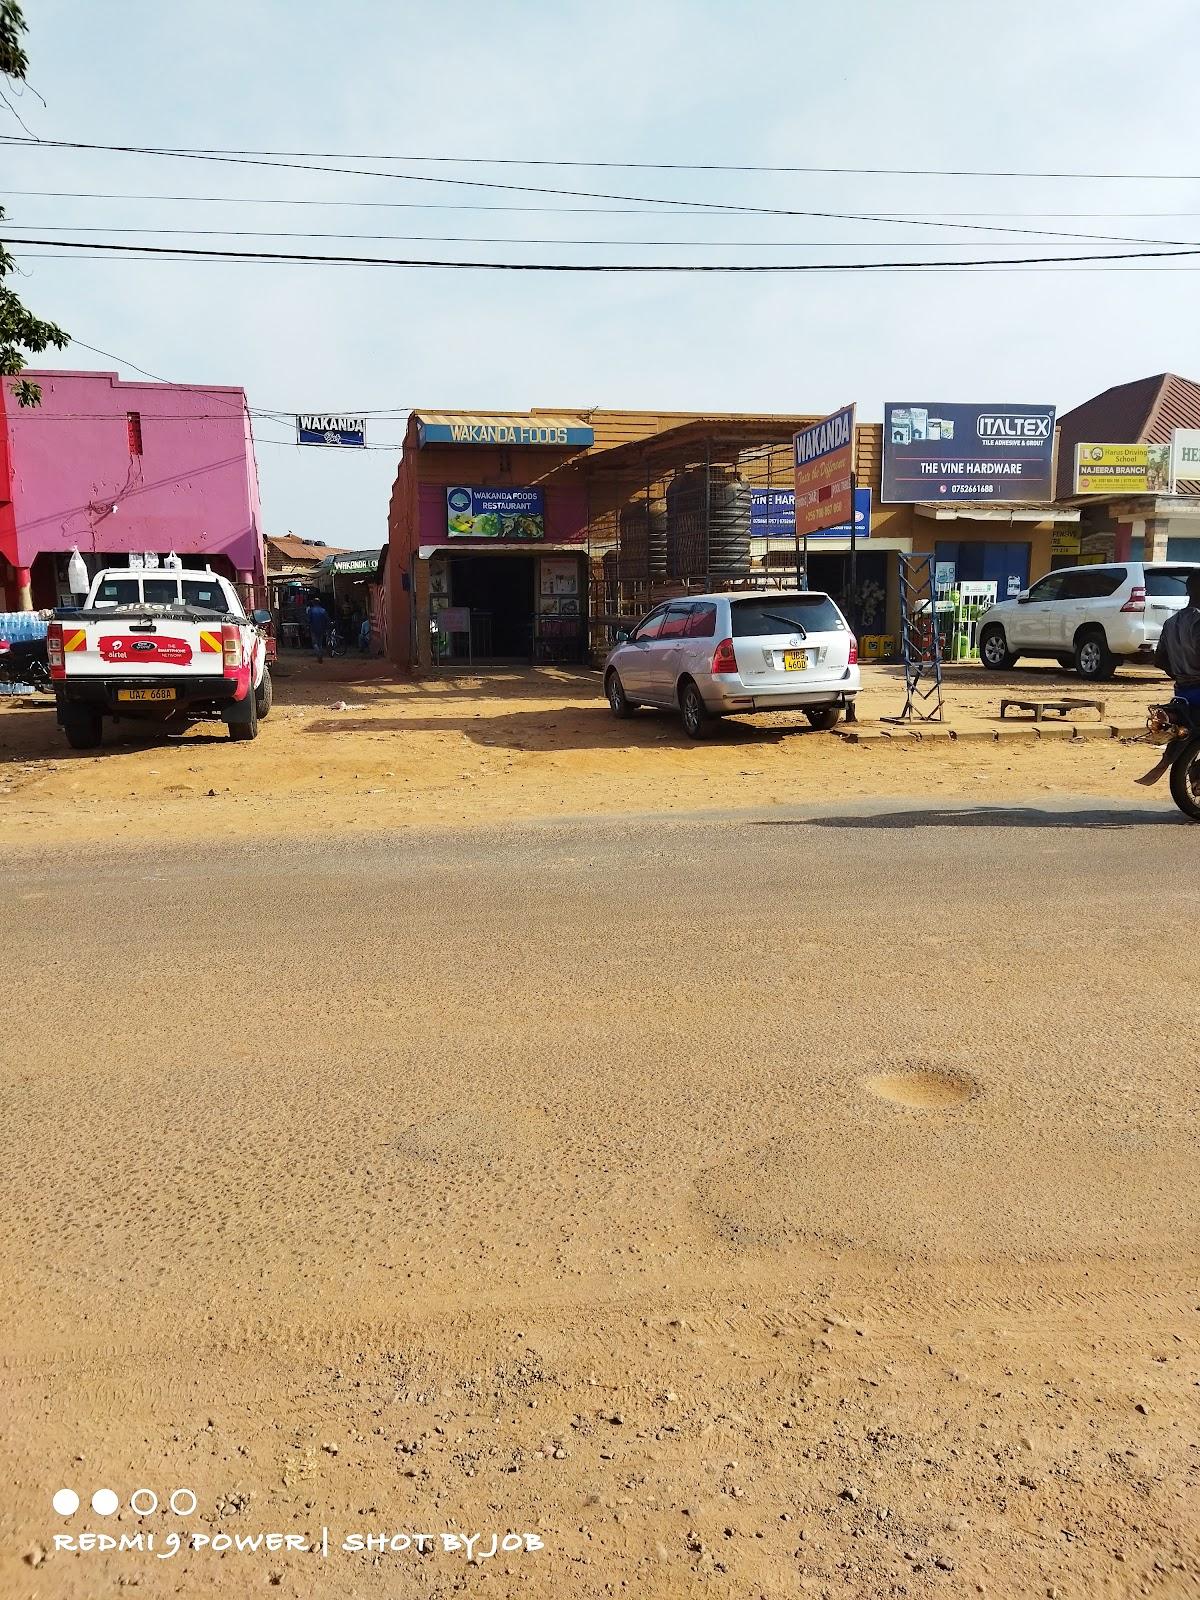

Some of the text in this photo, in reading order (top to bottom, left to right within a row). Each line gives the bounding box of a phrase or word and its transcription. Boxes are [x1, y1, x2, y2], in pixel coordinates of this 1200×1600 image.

[300, 415, 364, 432] WAKANDA
[979, 417, 1049, 437] ITALTEX
[450, 425, 568, 444] WAKANDA FOODS
[797, 413, 850, 463] WAKANDA
[1124, 449, 1148, 457] Driving
[1182, 447, 1200, 462] HE
[920, 463, 1022, 474] THE VINE HARDWARE
[1081, 466, 1145, 474] NAJEERA BRANCH
[951, 484, 994, 493] 0752661688
[474, 491, 538, 501] WAKANDA FOODS
[482, 501, 532, 511] RESTAURANT
[334, 560, 367, 570] WAKANDA
[108, 651, 128, 659] airtel
[129, 690, 171, 700] UAZ 668A
